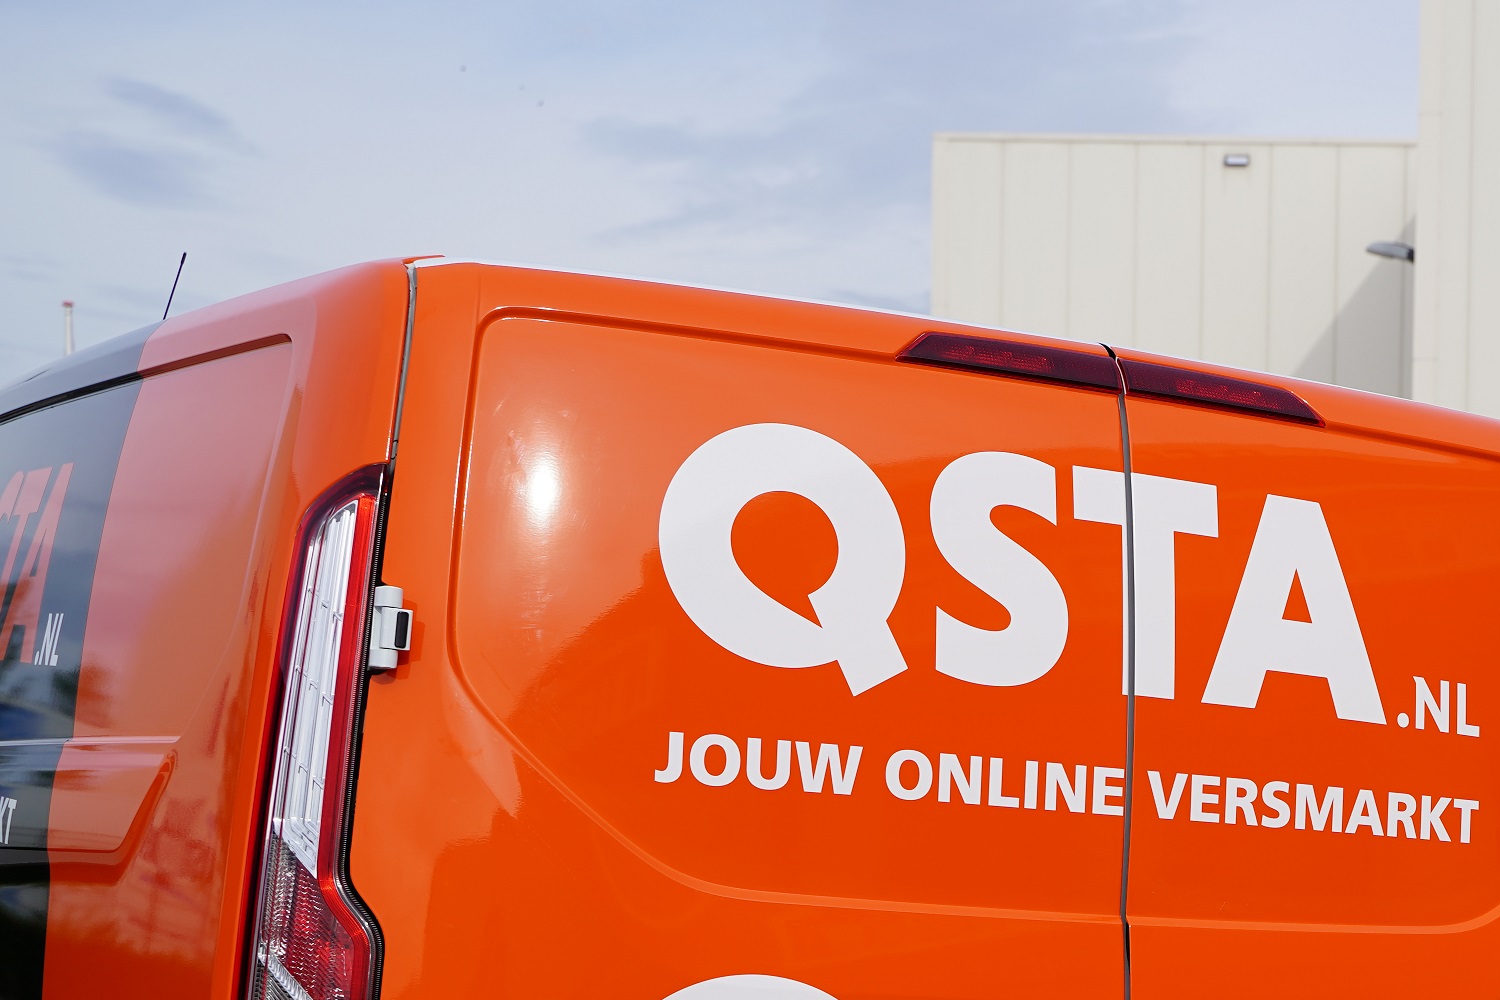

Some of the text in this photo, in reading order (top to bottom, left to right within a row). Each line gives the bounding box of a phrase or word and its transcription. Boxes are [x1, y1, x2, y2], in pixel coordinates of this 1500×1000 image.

[654, 731, 1480, 843] JOUW ONLINE VERSMARKT
